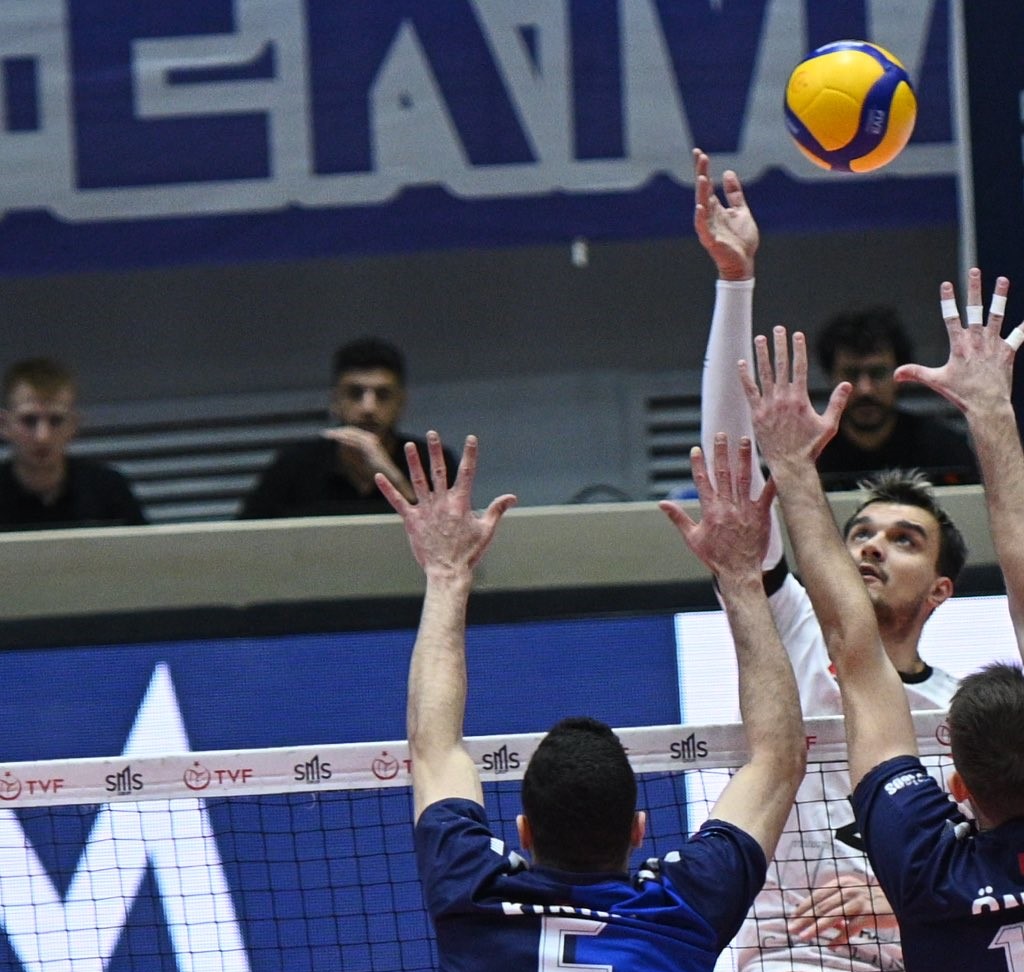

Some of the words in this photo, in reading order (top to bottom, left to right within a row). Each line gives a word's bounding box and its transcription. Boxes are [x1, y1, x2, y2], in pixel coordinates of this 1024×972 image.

[481, 744, 521, 773] SMS
[670, 732, 709, 761] SMS
[105, 765, 144, 795] SMS
[213, 768, 254, 785] TVF
[294, 755, 333, 783] SMS
[25, 779, 65, 795] TVF
